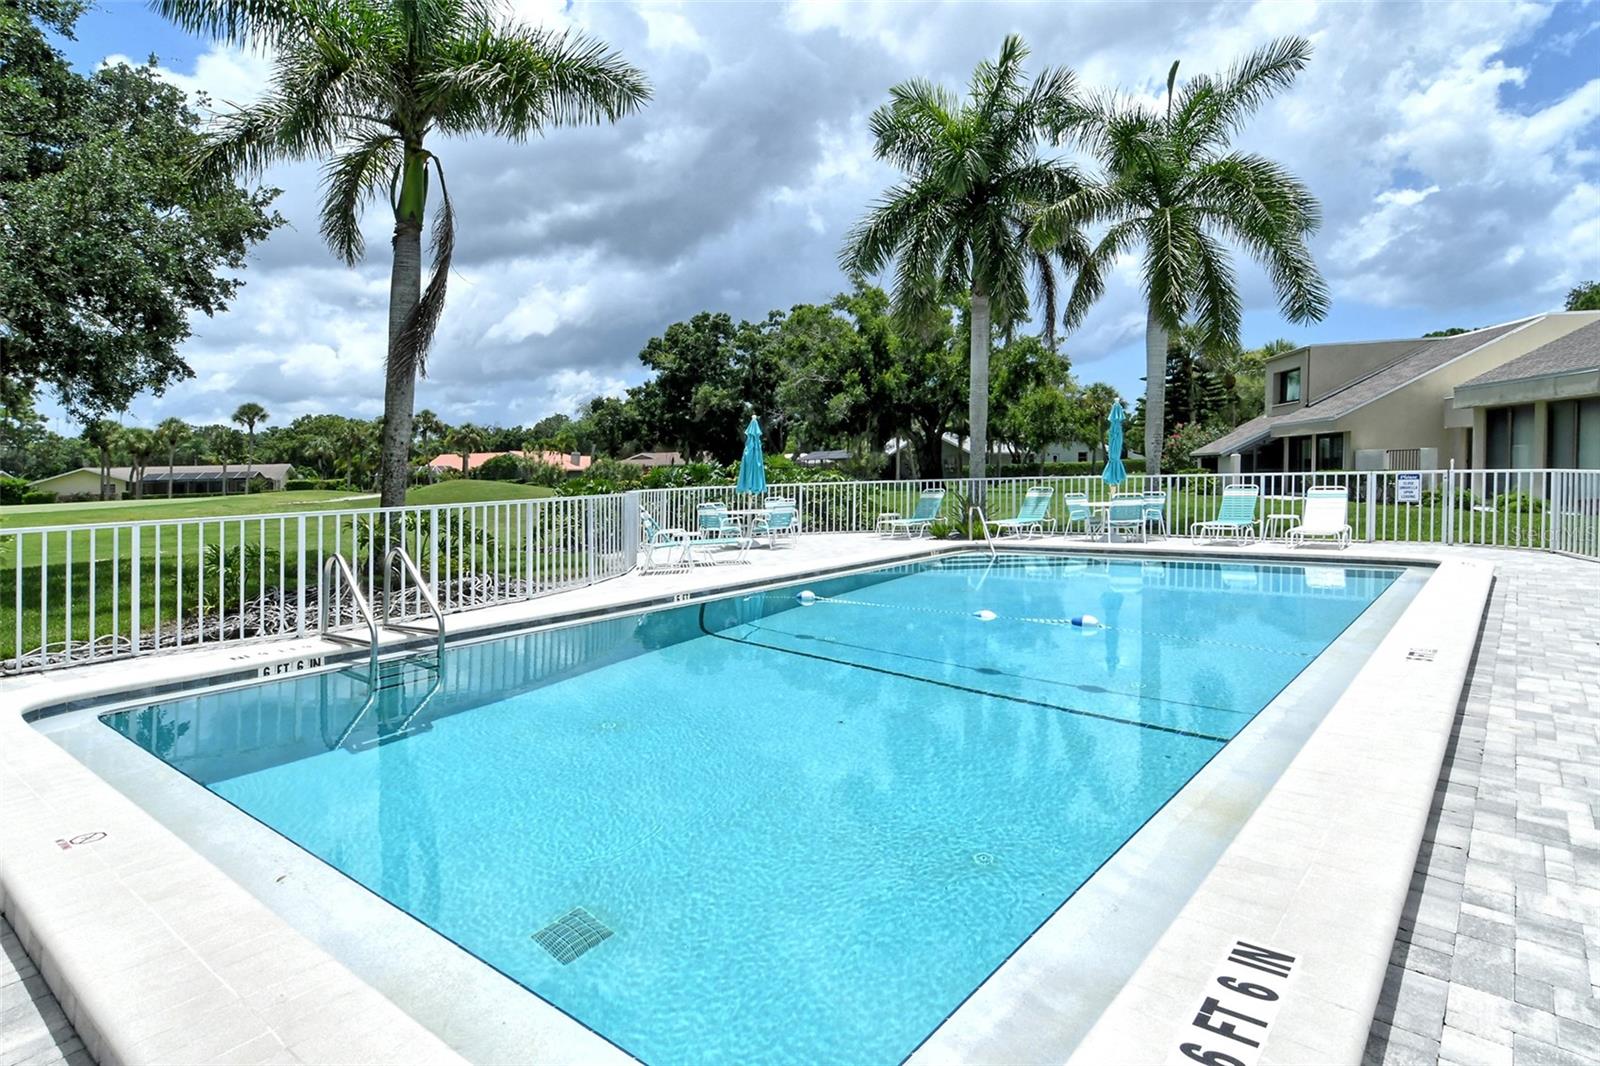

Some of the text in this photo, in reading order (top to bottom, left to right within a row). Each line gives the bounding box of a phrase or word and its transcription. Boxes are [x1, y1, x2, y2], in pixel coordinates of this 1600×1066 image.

[263, 657, 321, 677] 6 FT 6 IN
[1227, 940, 1296, 979] IN
[1216, 976, 1279, 1001] 6
[1192, 996, 1268, 1048] FT
